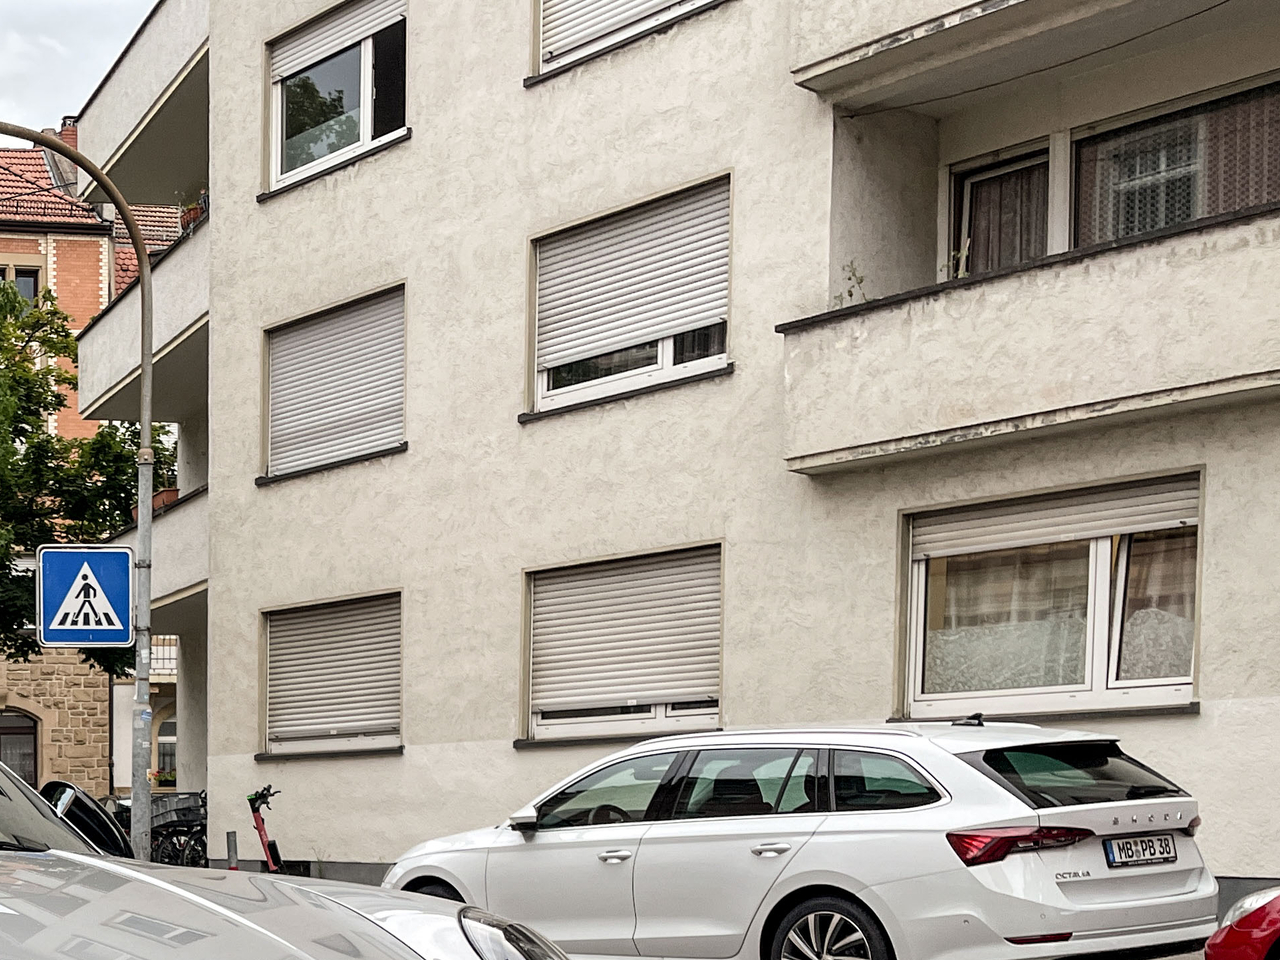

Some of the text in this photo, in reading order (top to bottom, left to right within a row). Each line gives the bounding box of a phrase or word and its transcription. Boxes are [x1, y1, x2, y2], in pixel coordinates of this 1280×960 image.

[1116, 837, 1171, 860] MB PB 38
[1055, 870, 1091, 880] OCTAVIA
